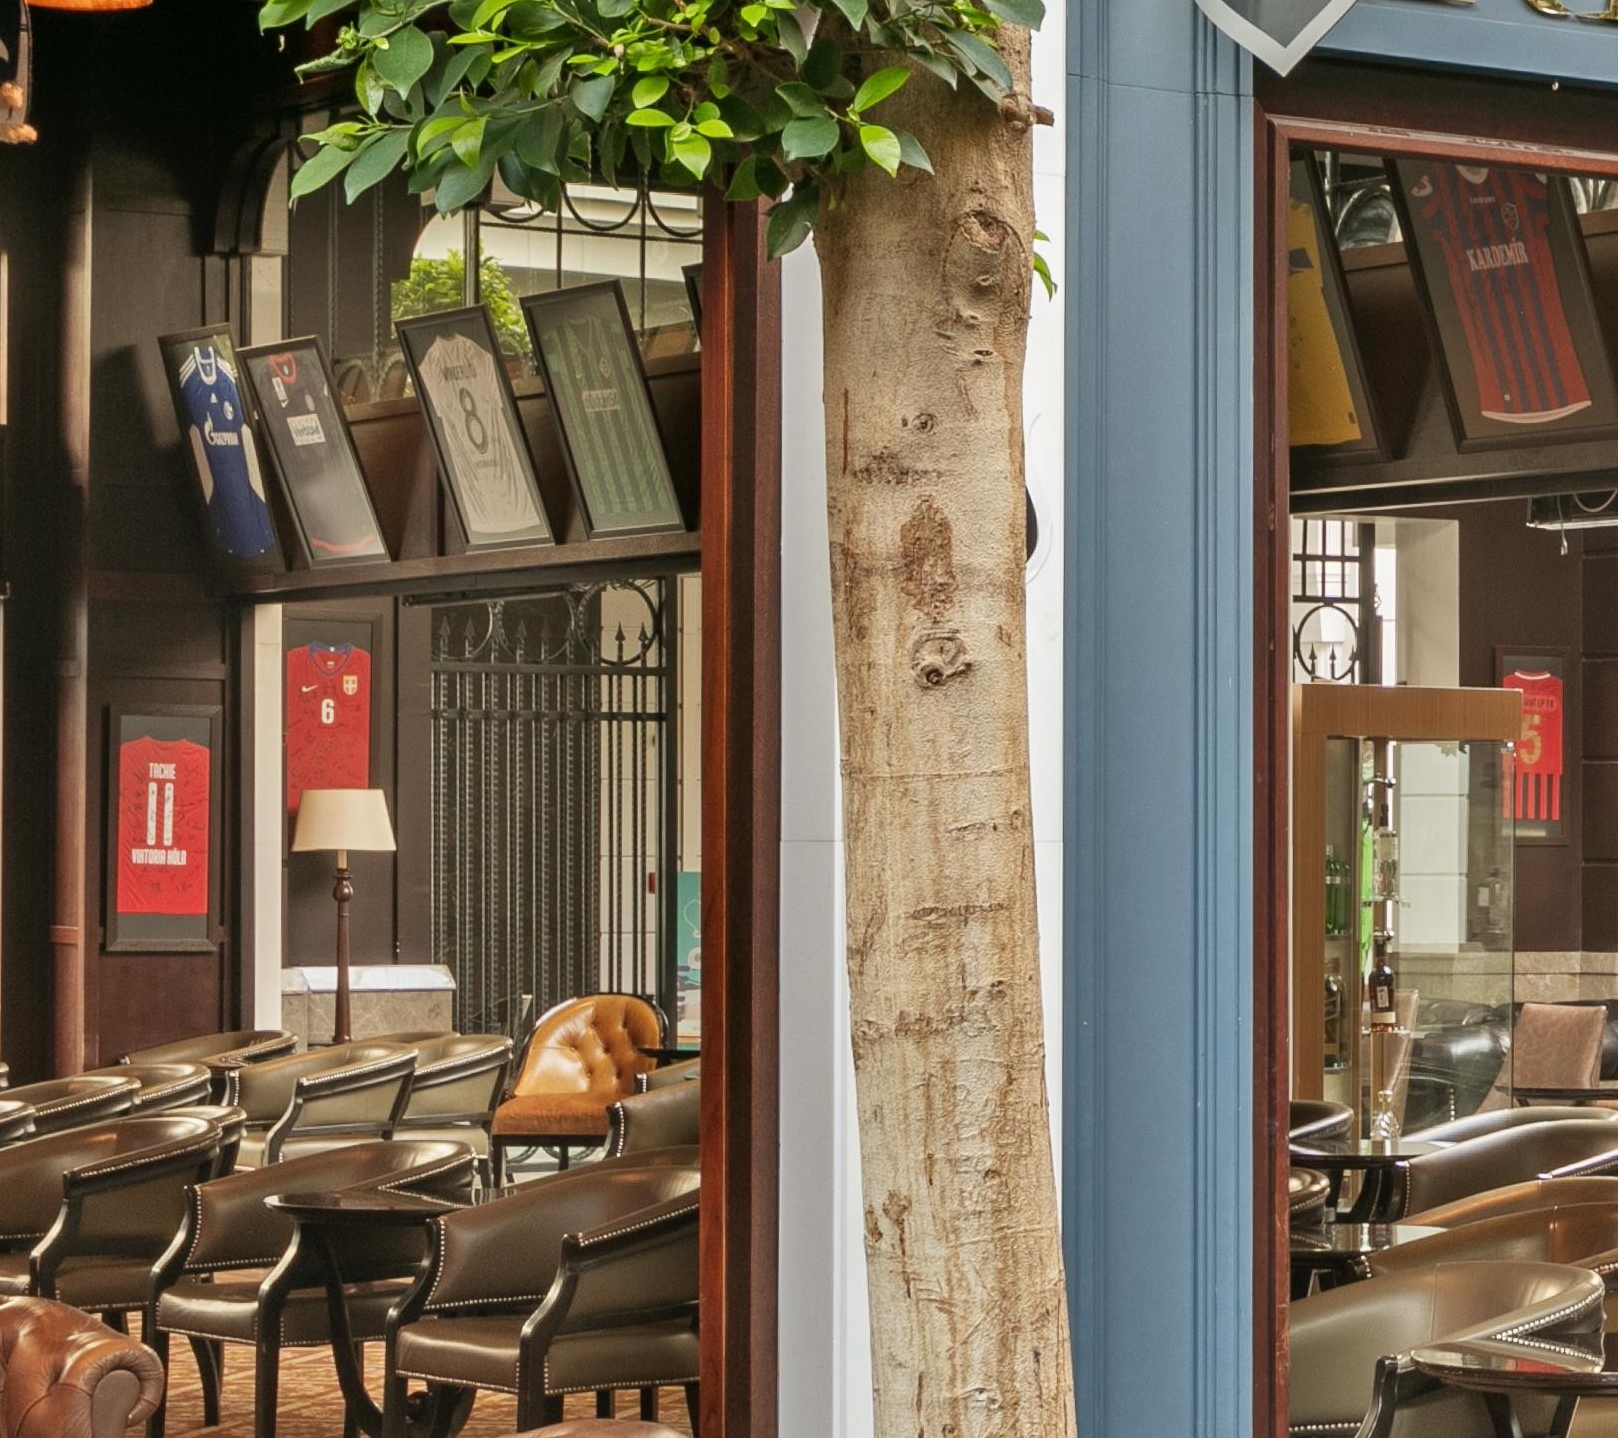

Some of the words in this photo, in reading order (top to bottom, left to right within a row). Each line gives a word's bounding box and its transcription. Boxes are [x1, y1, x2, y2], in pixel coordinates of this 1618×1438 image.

[459, 387, 489, 455] 8
[321, 698, 335, 725] 6
[146, 781, 175, 847] 11
[131, 848, 166, 866] VIKTORIA
